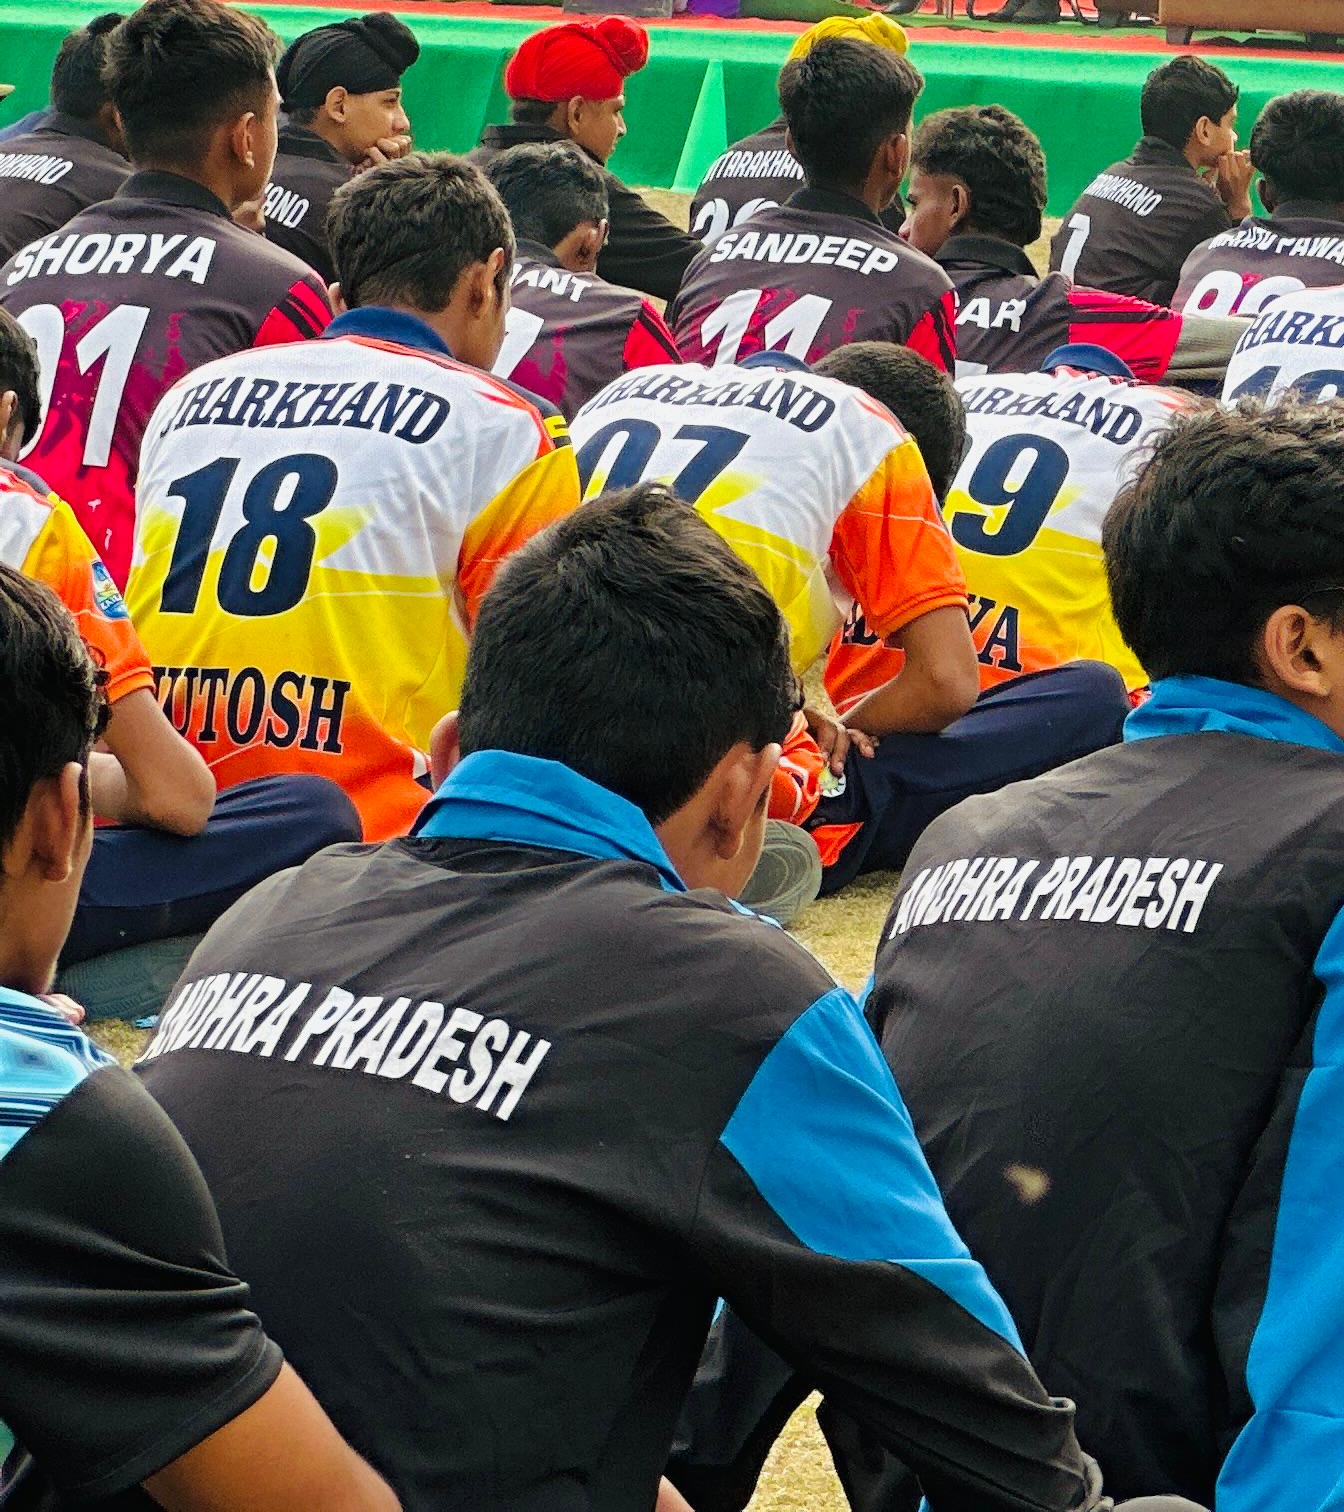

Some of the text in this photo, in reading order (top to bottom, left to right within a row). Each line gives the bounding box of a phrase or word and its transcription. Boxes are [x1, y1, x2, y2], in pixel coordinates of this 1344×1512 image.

[7, 232, 217, 286] SHORYA
[709, 231, 899, 277] SANDEEP
[160, 376, 451, 445] JHARKHAND
[576, 418, 751, 506] 07
[159, 452, 338, 616] 18
[888, 855, 1224, 940] ANDHRA PRADESH
[135, 971, 551, 1122] ANDHRA PRADESH
